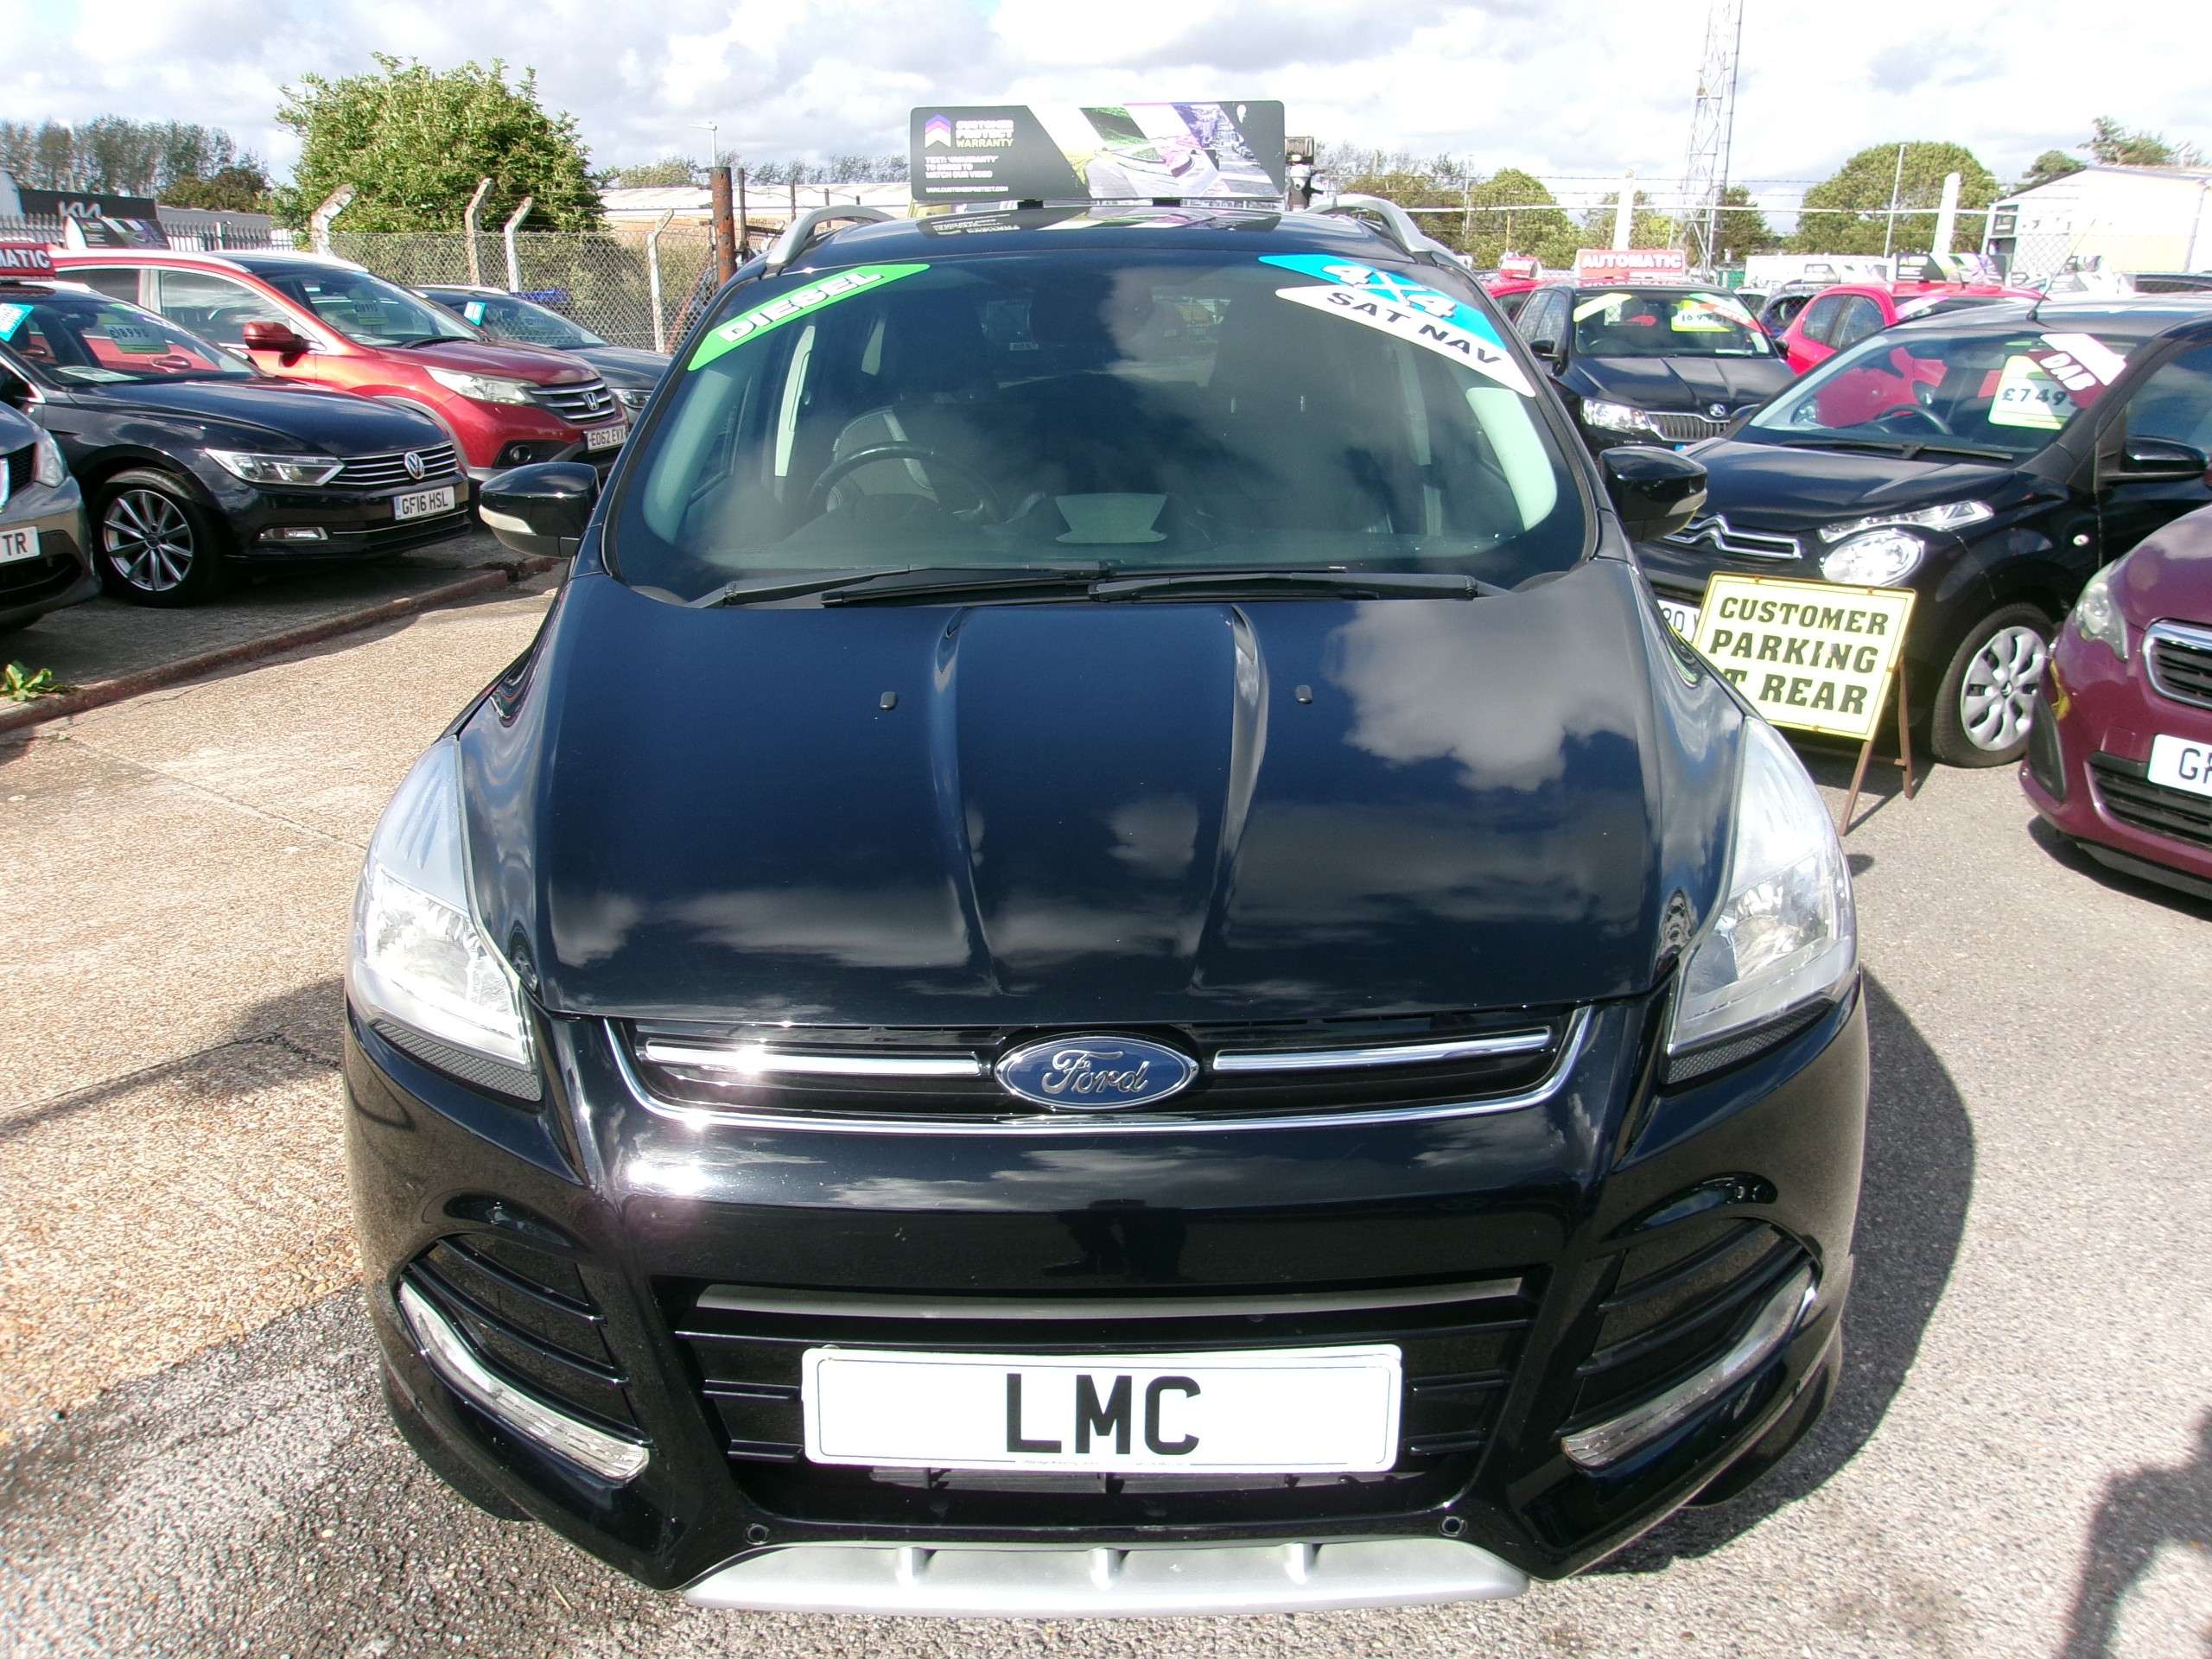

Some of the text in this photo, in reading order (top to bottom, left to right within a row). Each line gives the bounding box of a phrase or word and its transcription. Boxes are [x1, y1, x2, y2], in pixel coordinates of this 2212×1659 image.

[956, 138, 1014, 148] WARRANTY
[1582, 254, 1682, 269] AUTOMATIC
[718, 273, 885, 342] DIESEL
[1327, 292, 1501, 364] SAT NAV
[2039, 353, 2096, 391] DAB
[2002, 388, 2078, 408] £749
[402, 492, 448, 515] GF16 HSL
[1719, 596, 1889, 636] CUSTOMER
[1708, 629, 1878, 674] PARKING
[1758, 673, 1869, 715] REAR
[1041, 1049, 1150, 1094] Ford
[1006, 1373, 1201, 1455] LMC
